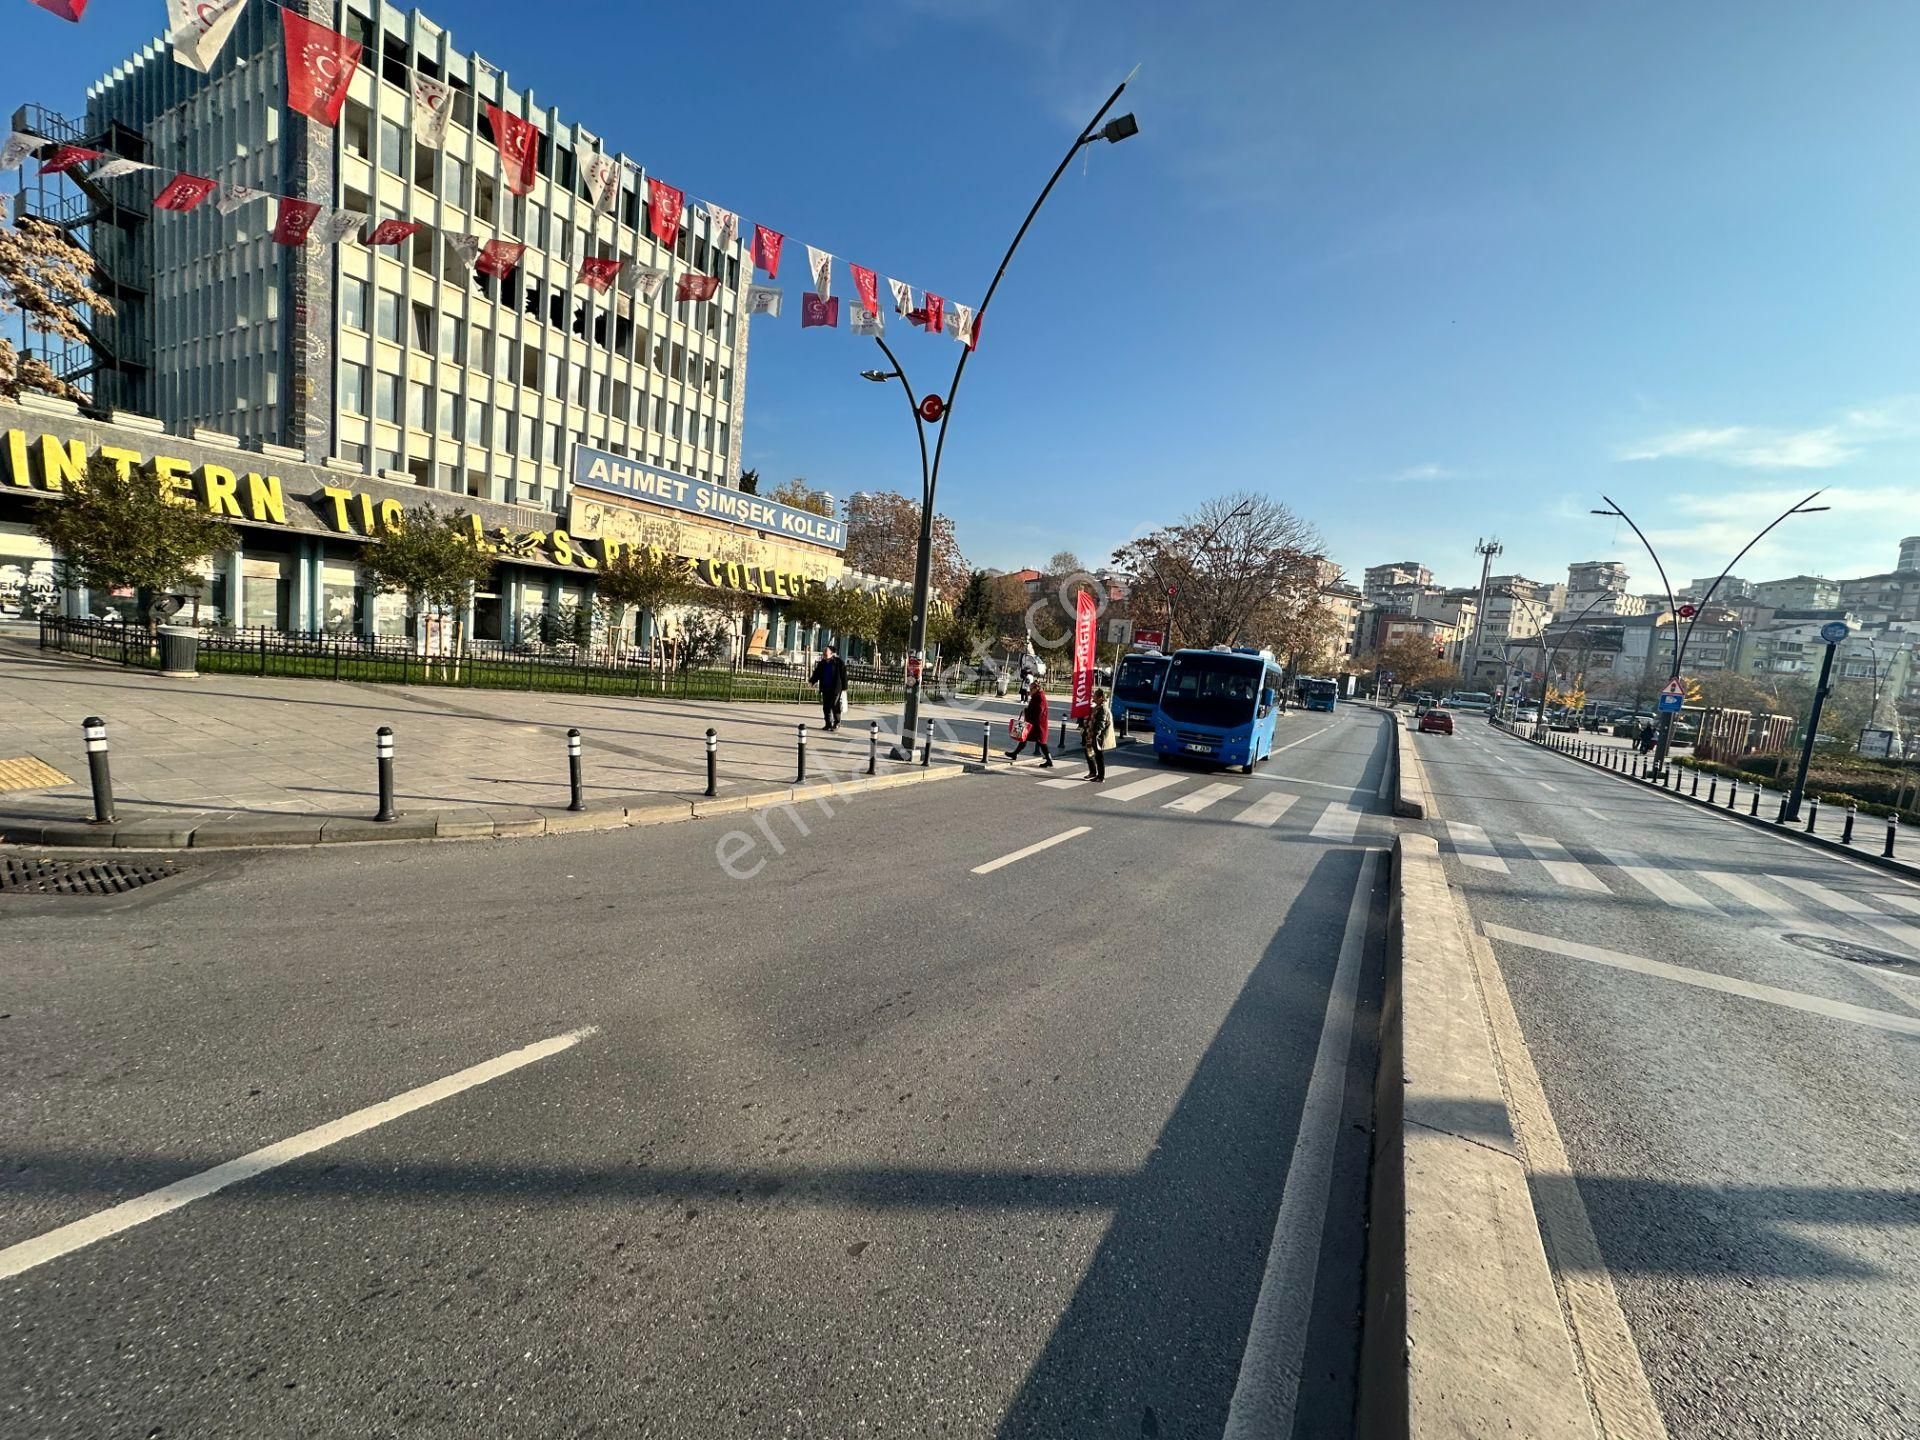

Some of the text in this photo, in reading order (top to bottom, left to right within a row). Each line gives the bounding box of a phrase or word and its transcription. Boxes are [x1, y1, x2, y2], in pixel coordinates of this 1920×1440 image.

[587, 457, 841, 544] AHMET ŞİMŞEK KOLEJİ
